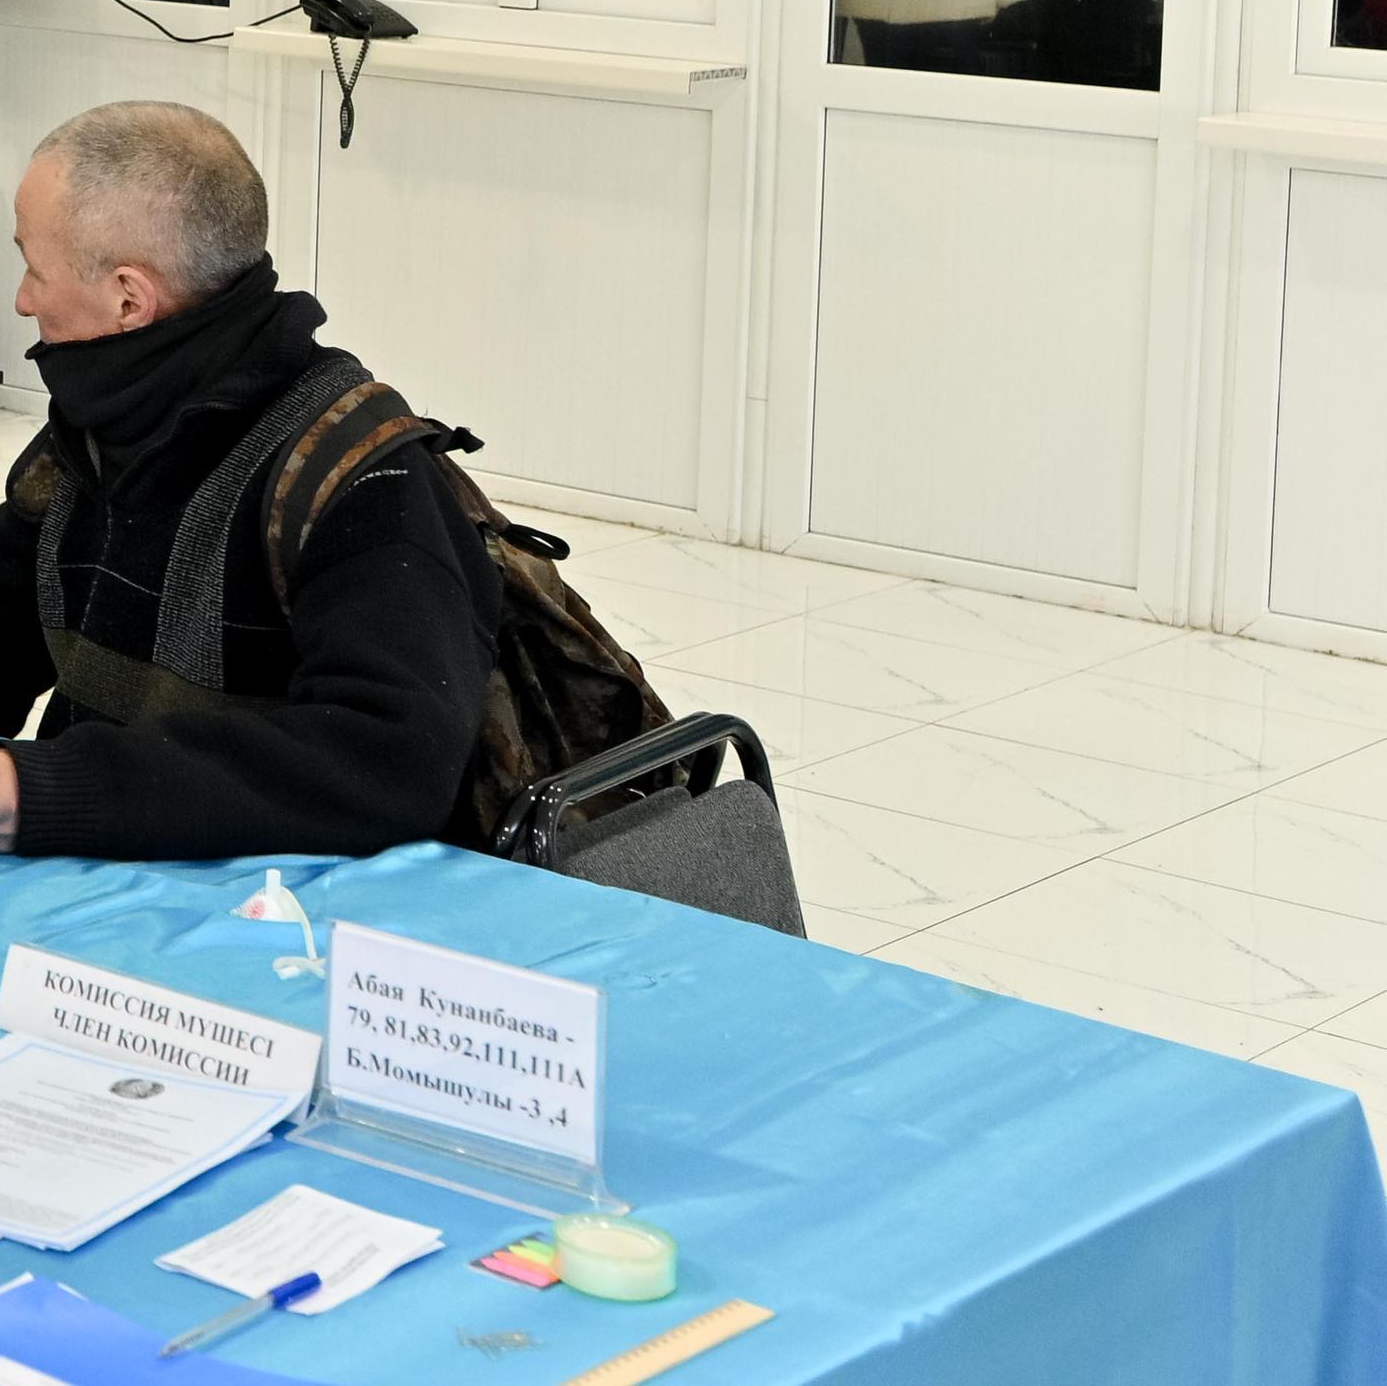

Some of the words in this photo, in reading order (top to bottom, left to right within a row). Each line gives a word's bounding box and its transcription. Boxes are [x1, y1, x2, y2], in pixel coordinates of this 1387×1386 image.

[43, 969, 170, 1027] КОМИССИЯ
[179, 1008, 274, 1059] МҮШЕСІ
[349, 971, 404, 1002] Абая
[419, 986, 559, 1043] Кунанбаева
[53, 1008, 110, 1047] ЧЛЕН
[118, 1027, 250, 1086] КОМИССИИ
[346, 1046, 512, 1112] Б.Момышулы
